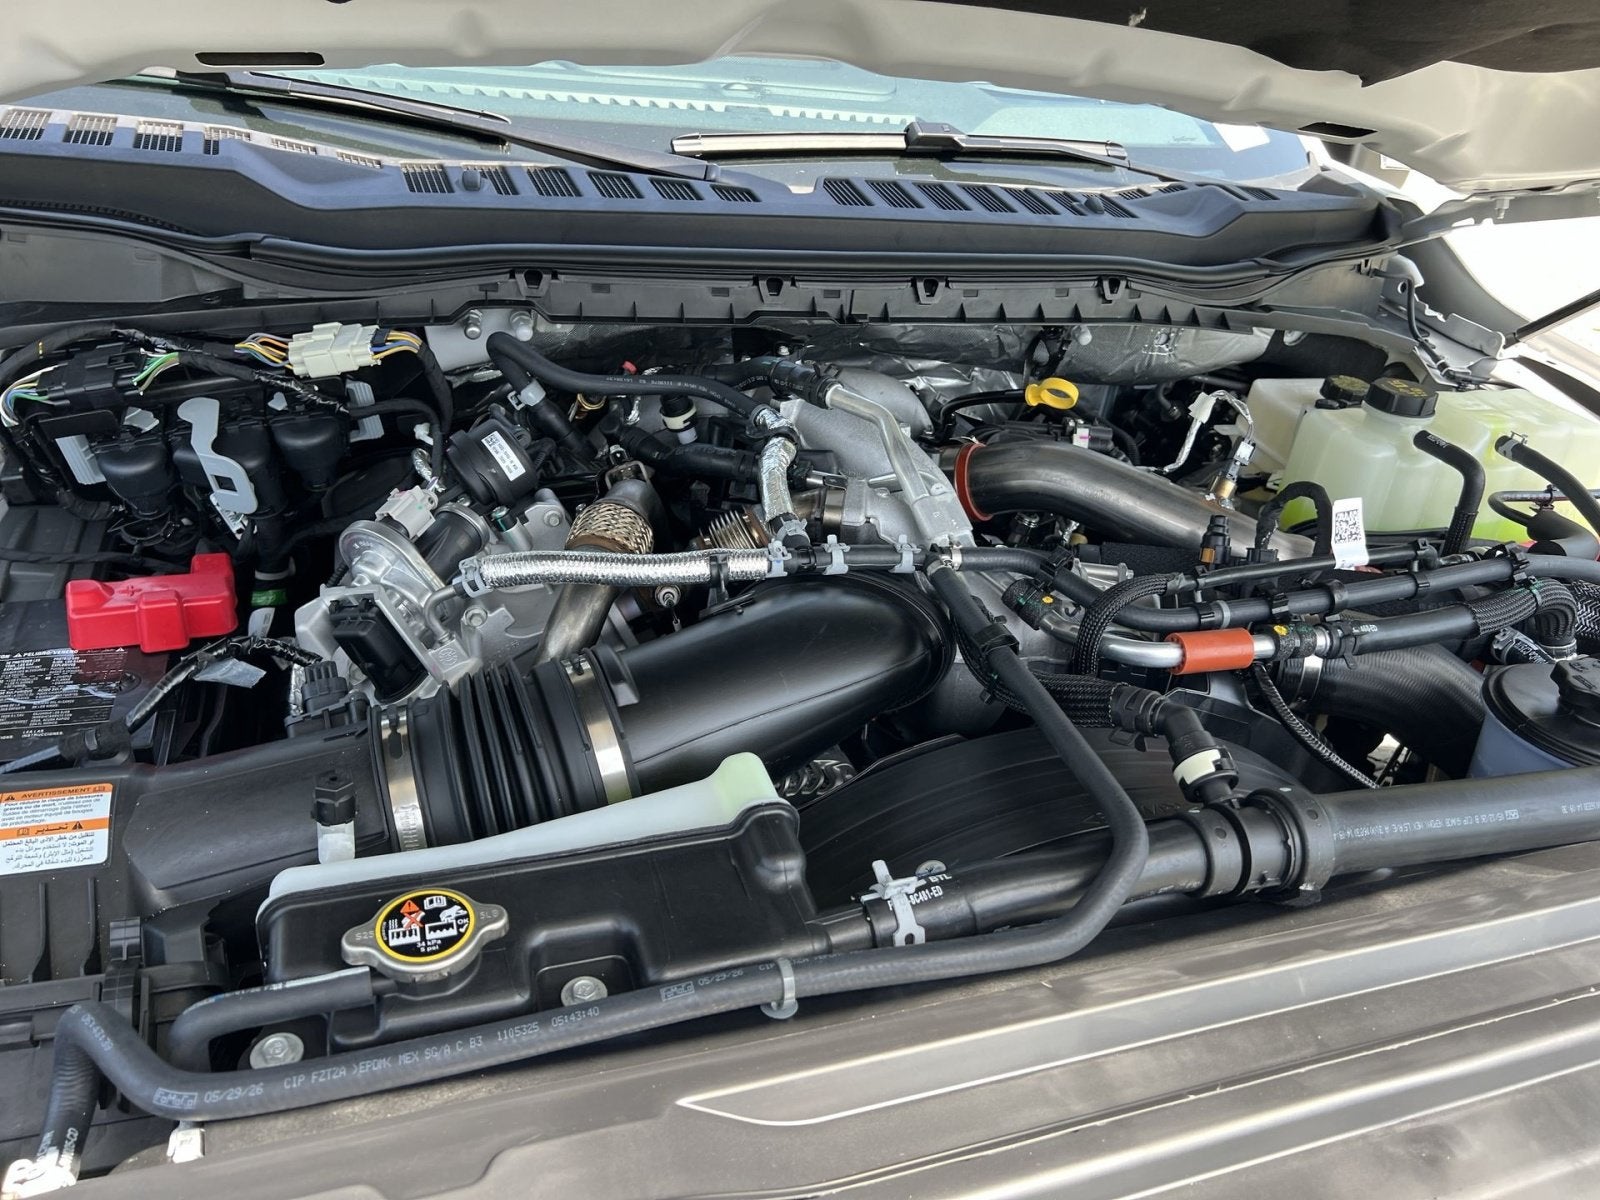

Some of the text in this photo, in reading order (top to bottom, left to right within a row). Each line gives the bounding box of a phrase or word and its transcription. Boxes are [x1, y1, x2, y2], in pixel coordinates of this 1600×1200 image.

[21, 787, 91, 799] AVERTISSEMENT
[928, 873, 953, 883] BTL
[457, 917, 469, 925] OK
[426, 945, 439, 953] psi
[204, 1082, 265, 1104] 05/29/26
[283, 1074, 306, 1089] CIP
[398, 1050, 419, 1066] MEX
[424, 1043, 451, 1060] SG/A
[455, 1040, 464, 1052] C
[469, 1035, 483, 1049] B3
[497, 1021, 540, 1041] 1105325
[551, 1006, 600, 1027] 05:43:40
